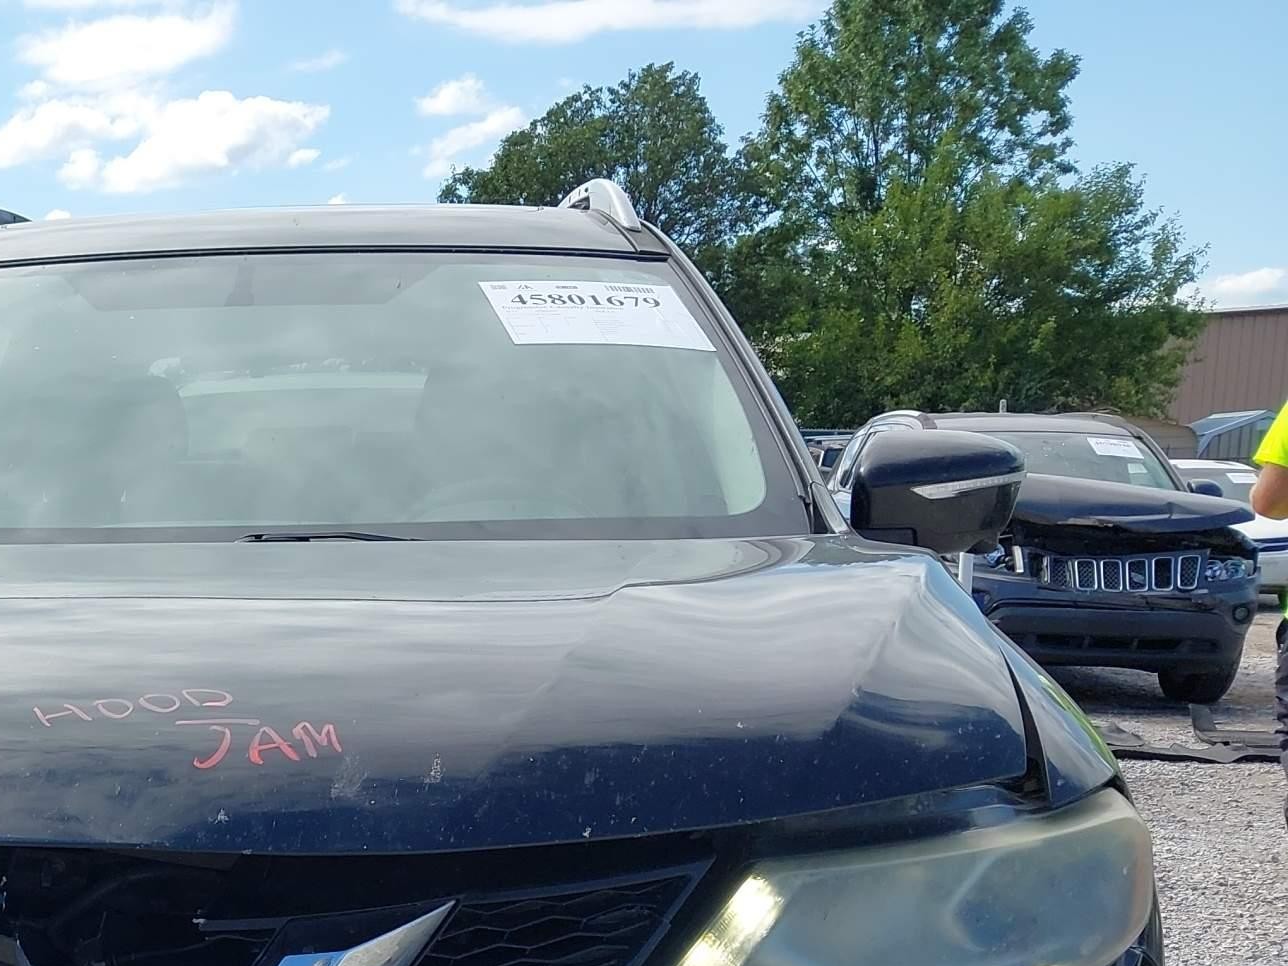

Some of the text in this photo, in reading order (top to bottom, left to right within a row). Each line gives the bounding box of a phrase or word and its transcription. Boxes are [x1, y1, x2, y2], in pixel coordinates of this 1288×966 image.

[510, 293, 661, 309] 45801679
[33, 688, 234, 728] HOOD
[193, 721, 342, 769] JAM
